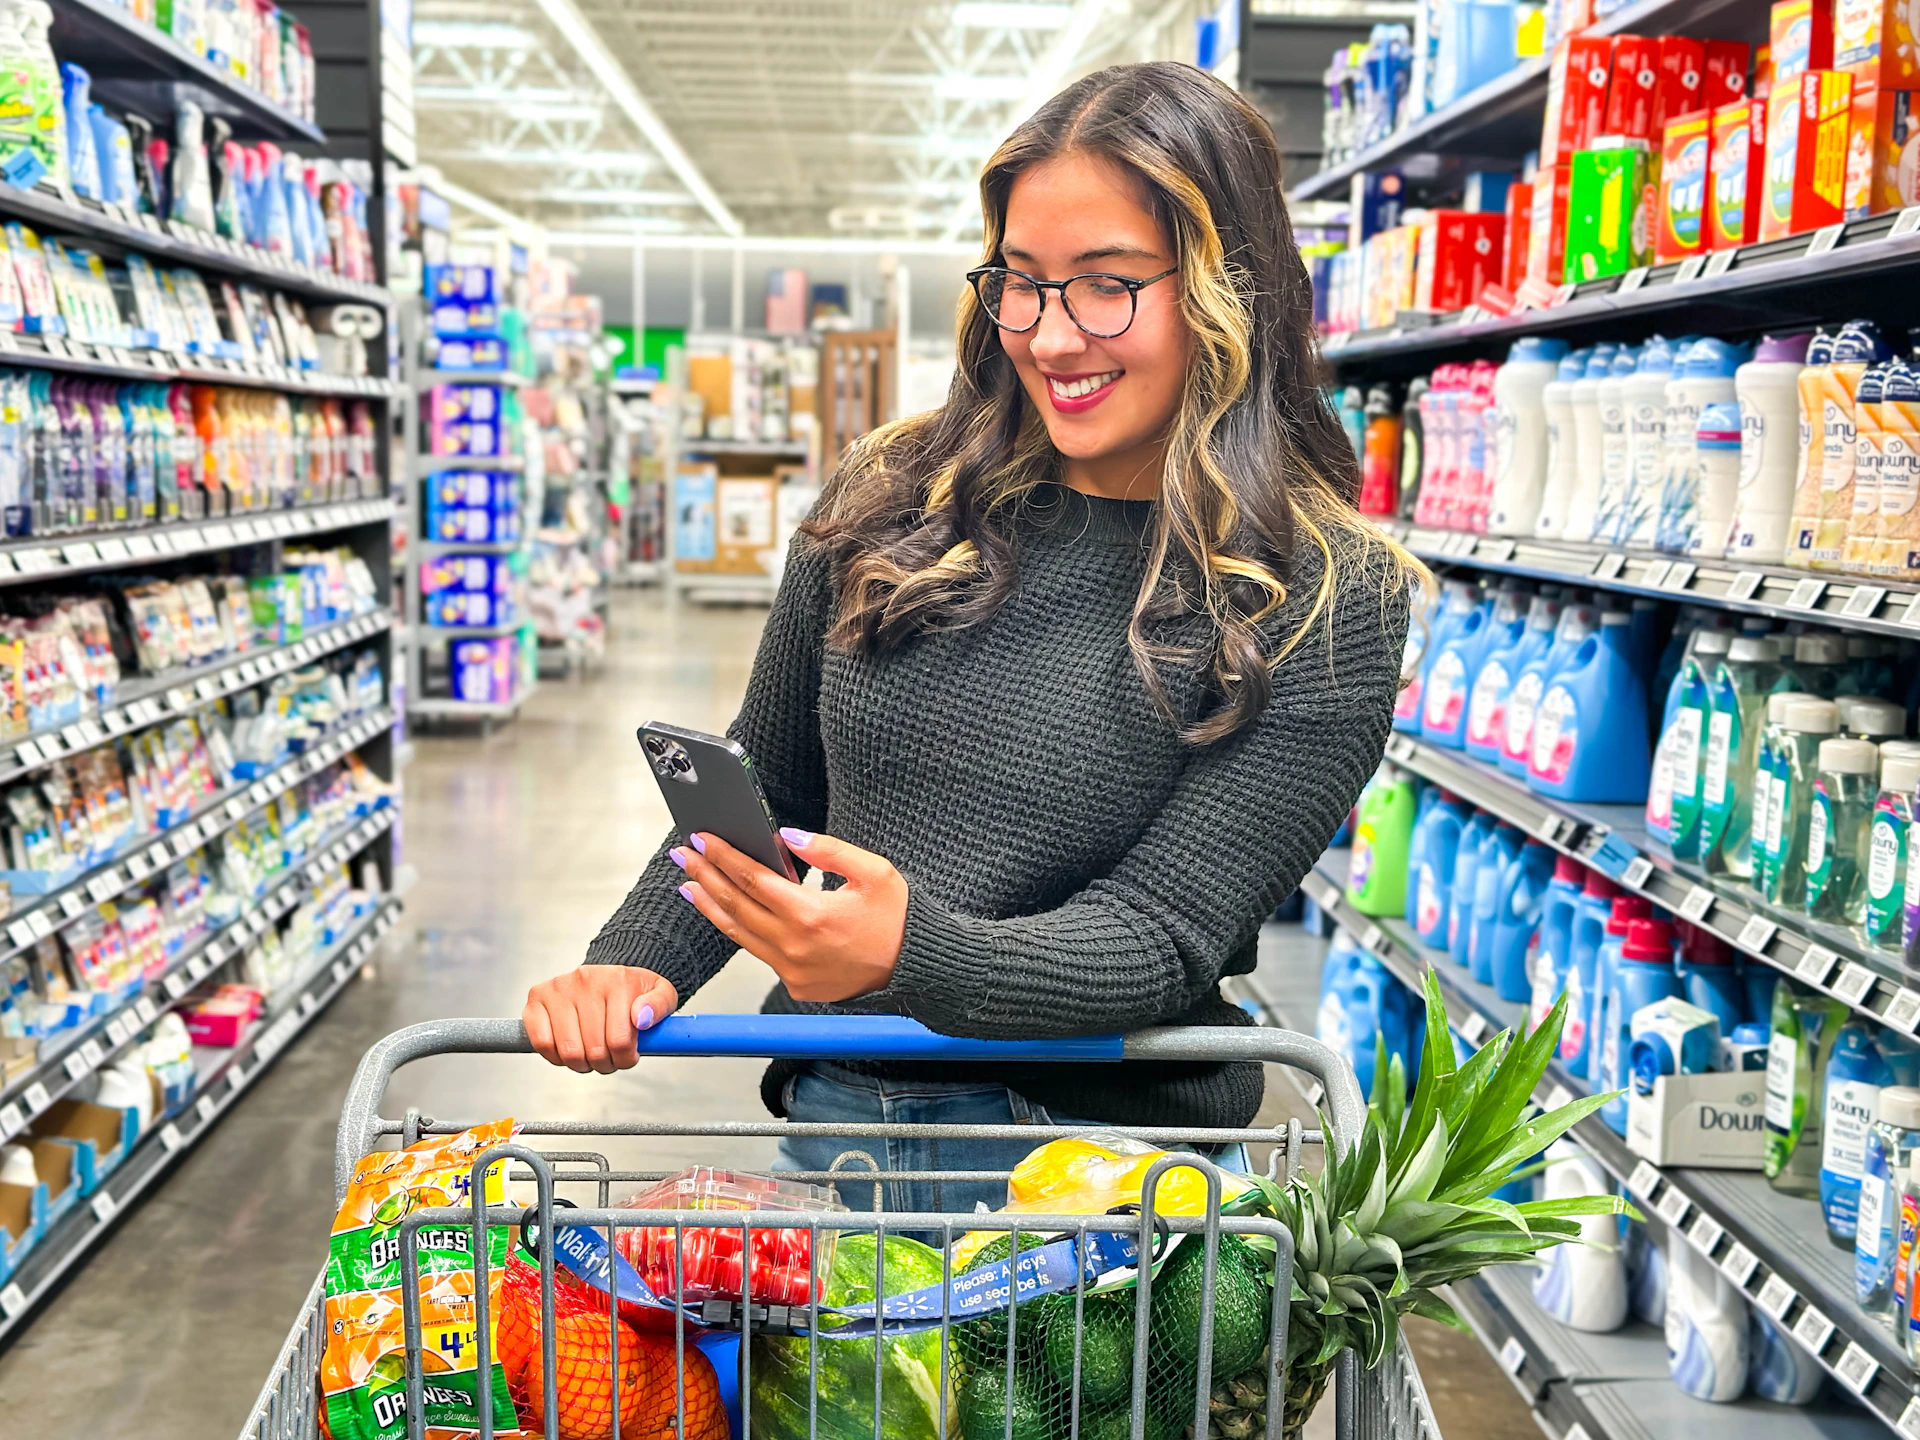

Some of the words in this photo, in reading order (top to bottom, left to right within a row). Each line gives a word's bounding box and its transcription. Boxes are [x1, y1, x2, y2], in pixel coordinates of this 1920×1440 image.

[1831, 1096, 1870, 1124] Downy
[371, 1230, 468, 1269] ORNGES
[953, 1269, 998, 1294] Please:
[1002, 1253, 1047, 1279] Aways
[960, 1293, 982, 1309] use
[985, 1283, 1010, 1302] sea
[1017, 1272, 1052, 1293] bets.
[441, 1331, 464, 1359] 4
[373, 1386, 473, 1428] ORNGES
